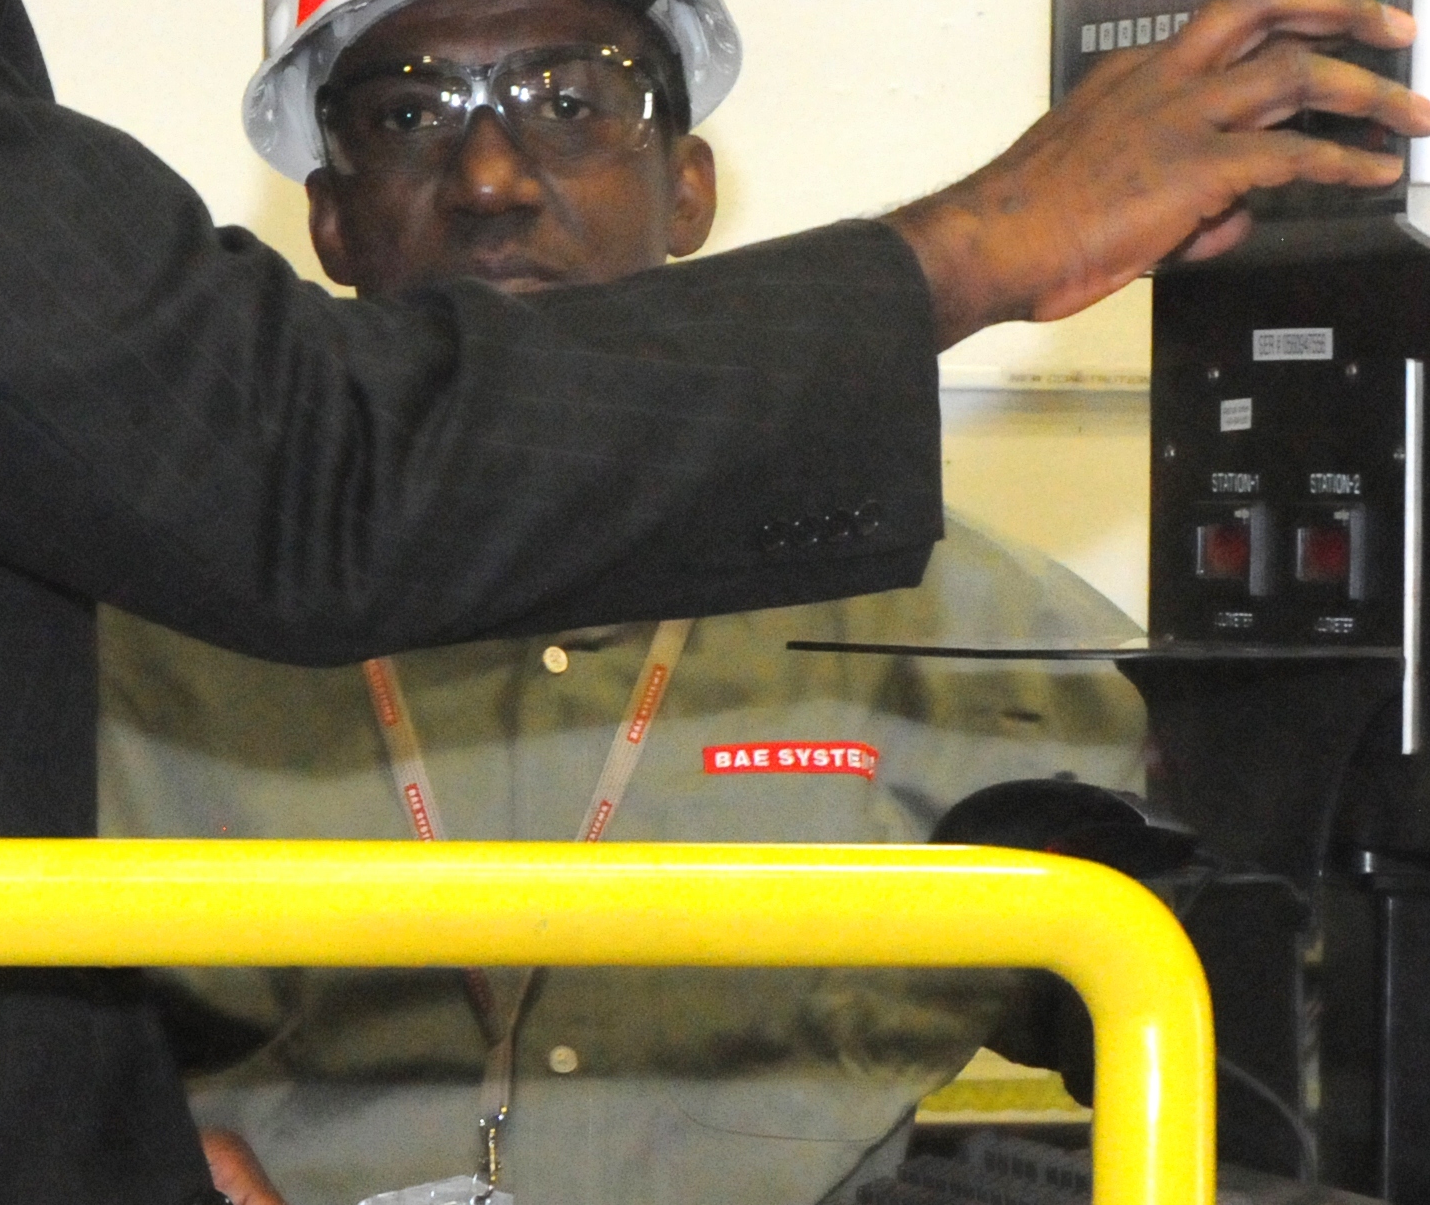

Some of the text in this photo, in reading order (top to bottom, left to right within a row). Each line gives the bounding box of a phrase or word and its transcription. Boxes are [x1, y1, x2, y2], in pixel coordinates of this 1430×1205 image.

[1310, 472, 1361, 495] STATION-2
[714, 747, 875, 770] BAE SYSTE
[408, 787, 432, 842] BAE SYST
